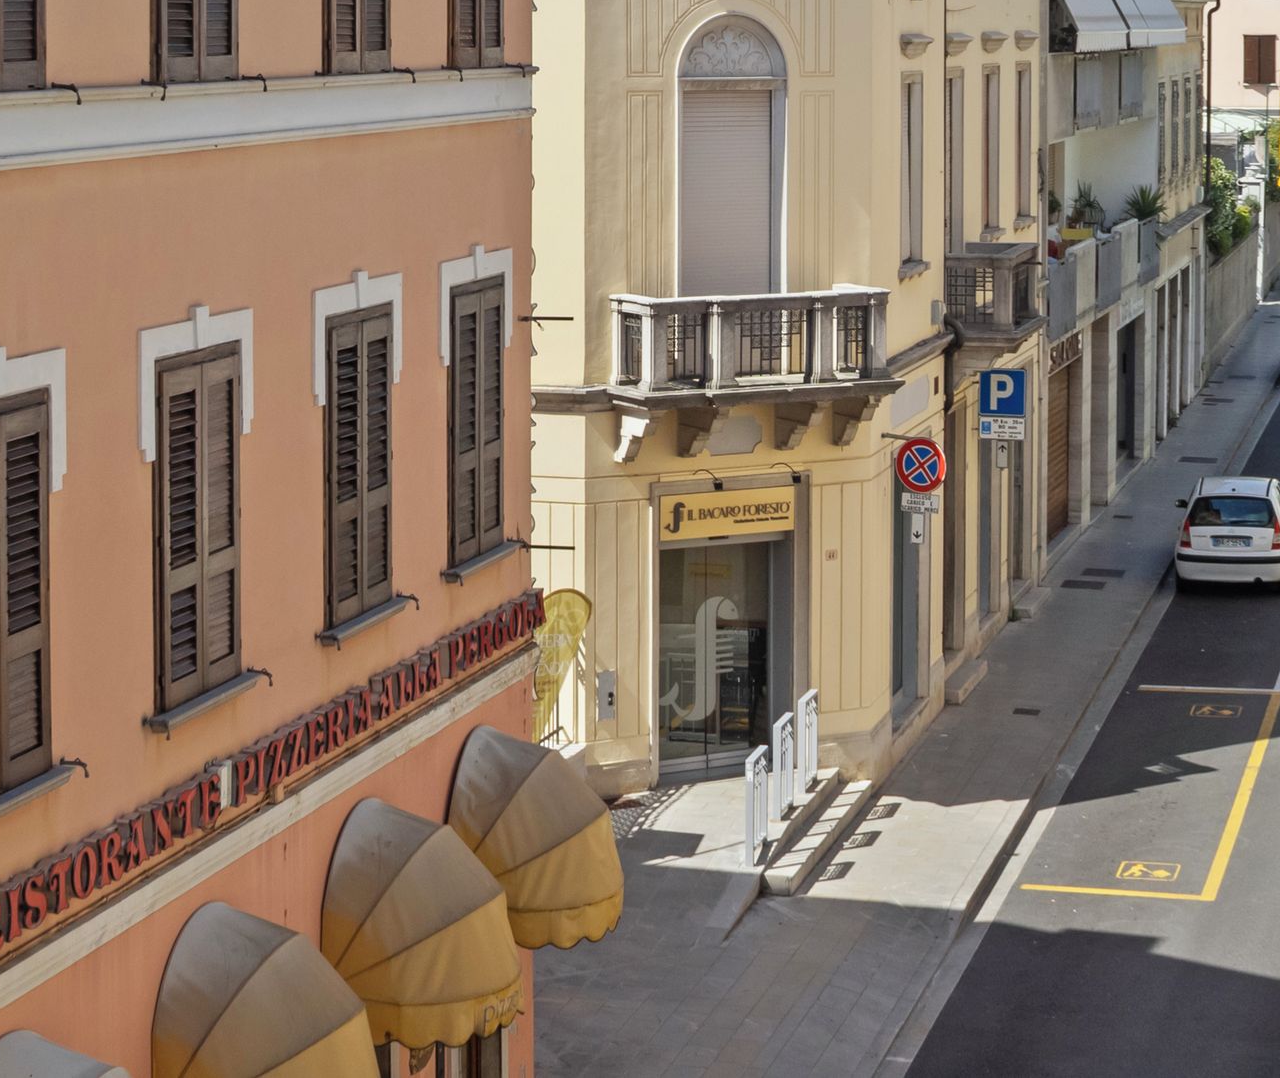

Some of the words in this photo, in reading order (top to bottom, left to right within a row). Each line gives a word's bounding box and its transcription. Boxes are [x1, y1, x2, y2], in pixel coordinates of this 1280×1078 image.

[990, 374, 1014, 410] P
[687, 509, 697, 521] IL
[924, 506, 938, 514] MERCI
[235, 685, 374, 807] PIZZERIA
[380, 646, 442, 720] ALLA
[450, 589, 546, 679] PERGOLA
